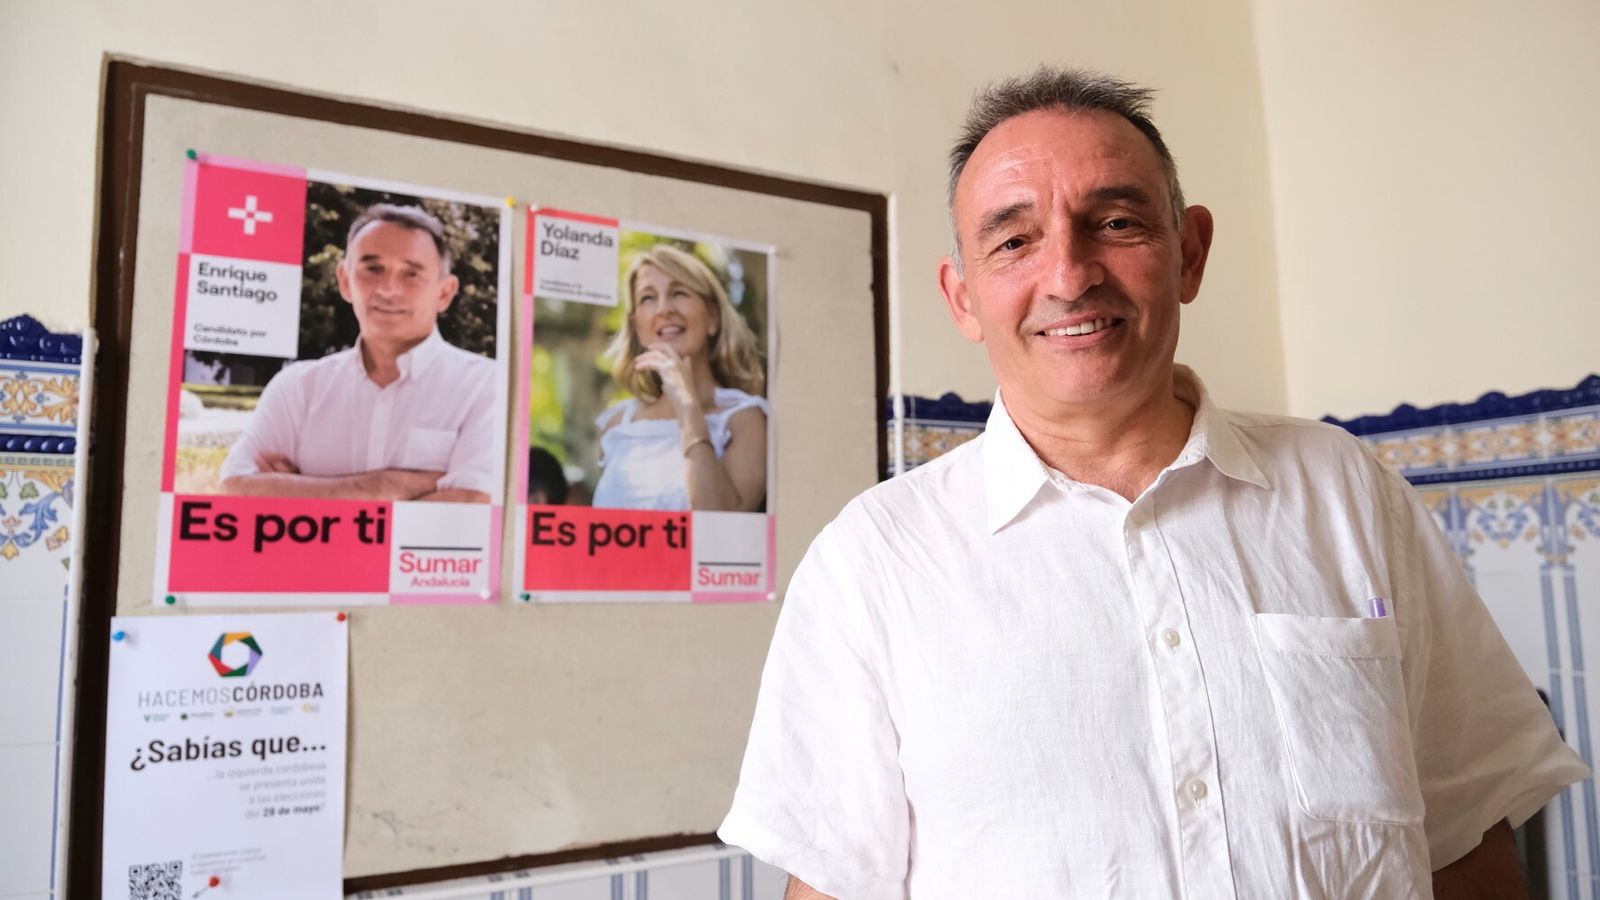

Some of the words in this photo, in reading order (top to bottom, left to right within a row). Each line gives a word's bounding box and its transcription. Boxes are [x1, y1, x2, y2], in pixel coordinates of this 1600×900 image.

[542, 222, 613, 248] Yolanda
[541, 240, 579, 260] Díaz
[198, 262, 267, 283] Enrique
[197, 280, 277, 303] Santiago
[194, 322, 248, 336] Candidato
[249, 329, 267, 338] por
[180, 502, 238, 541] Es
[253, 513, 340, 553] por
[354, 507, 386, 544] ti
[532, 512, 577, 546] Es
[588, 522, 653, 556] por
[663, 516, 687, 548] ti
[400, 552, 482, 573] Sumar
[410, 576, 470, 587] Andalucía
[698, 567, 760, 586] Sumar
[130, 737, 242, 771] ¿Sabías
[252, 735, 326, 760] que...
[227, 766, 273, 778] izquierda
[275, 763, 326, 773] cordobesa
[253, 779, 297, 791] presenta
[262, 807, 275, 817] 28
[278, 806, 290, 816] de
